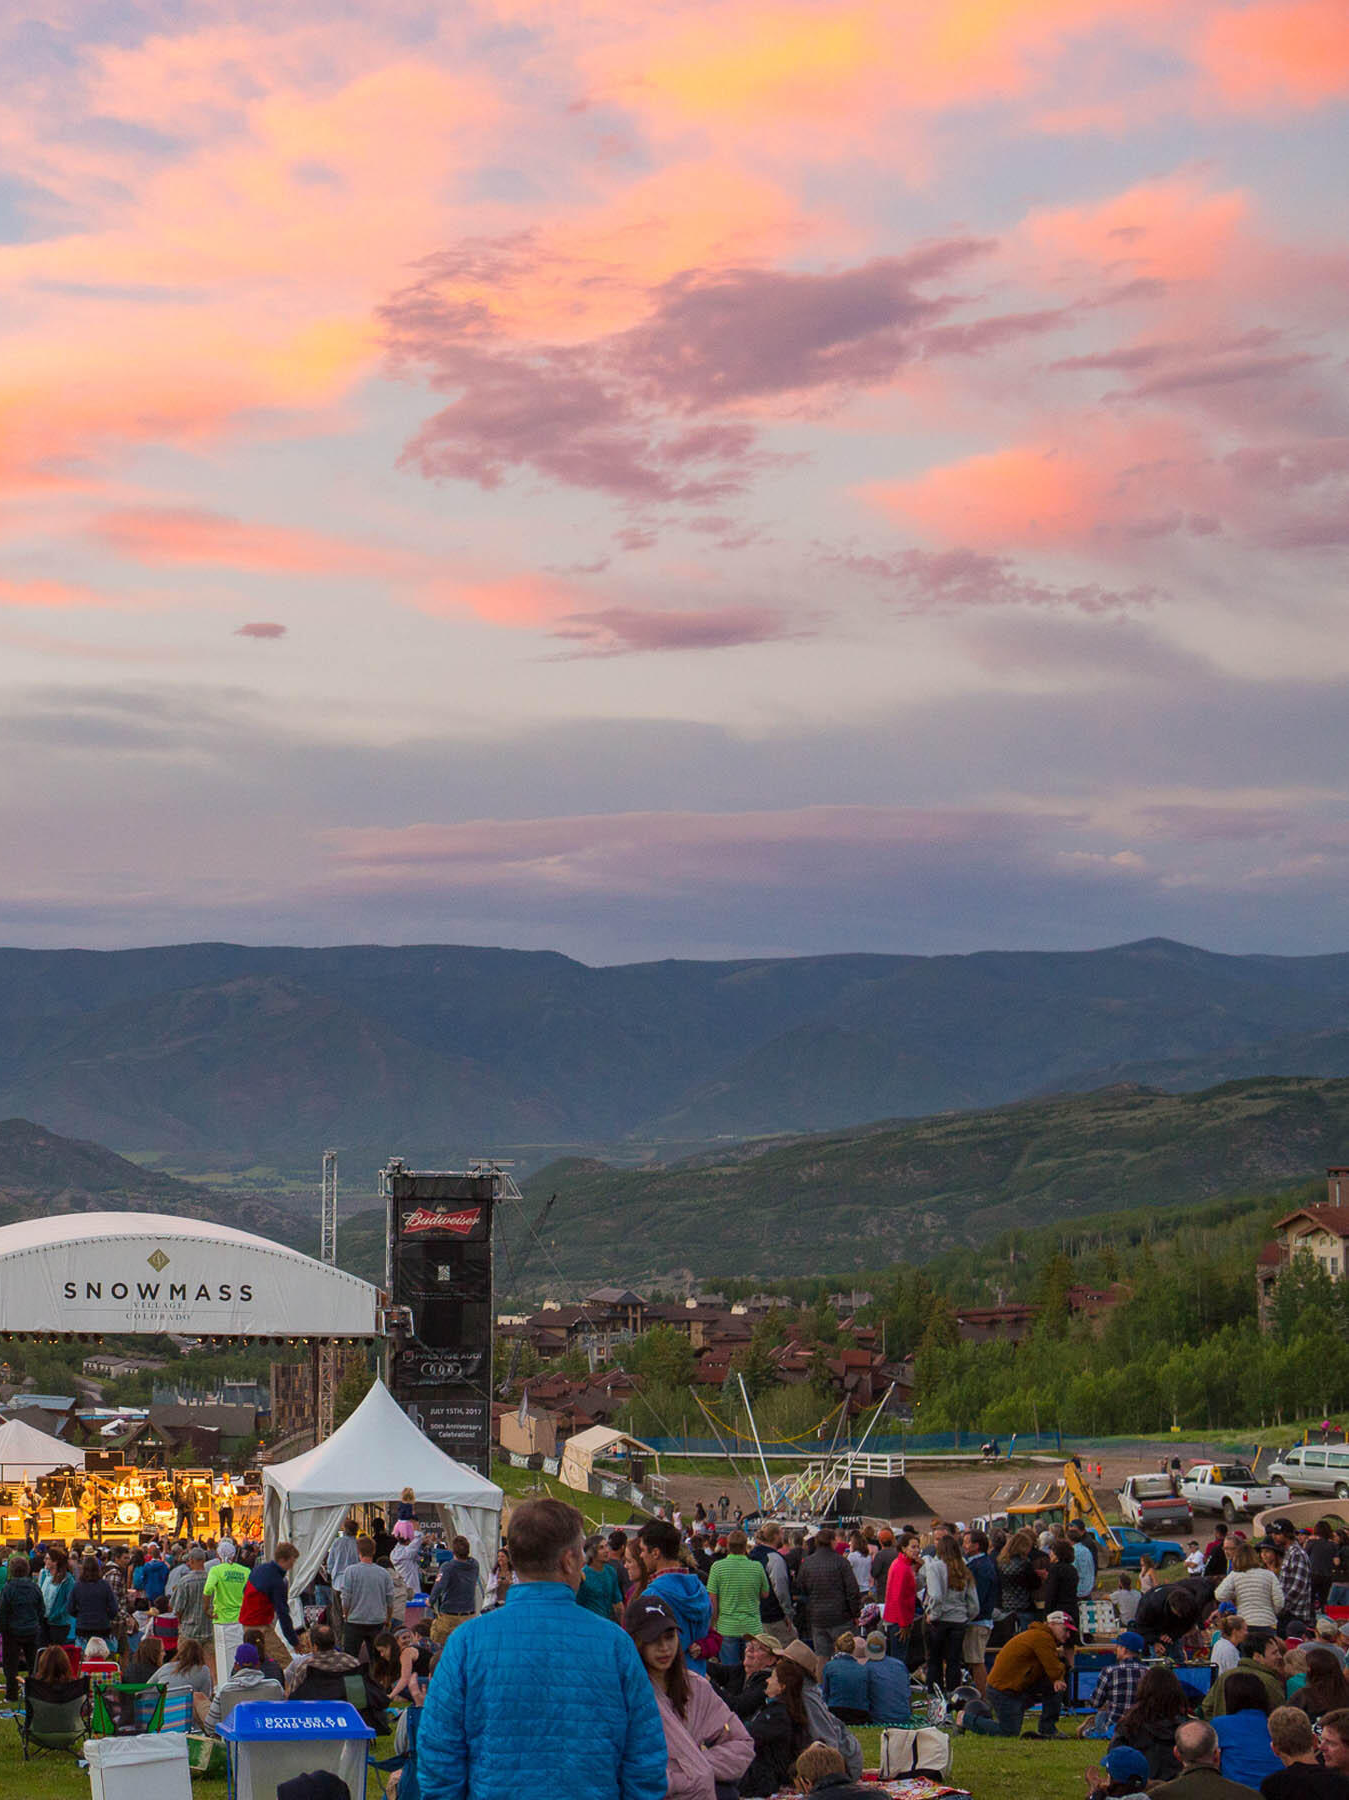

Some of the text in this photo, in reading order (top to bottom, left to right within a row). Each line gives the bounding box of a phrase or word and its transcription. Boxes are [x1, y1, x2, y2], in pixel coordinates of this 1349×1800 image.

[401, 1211, 481, 1228] Budweiser
[63, 1281, 254, 1302] SNOWMASS
[133, 1301, 183, 1309] VILLAGE
[125, 1312, 191, 1321] COLORADO
[461, 1352, 482, 1360] AUDI
[465, 1408, 482, 1416] 2017
